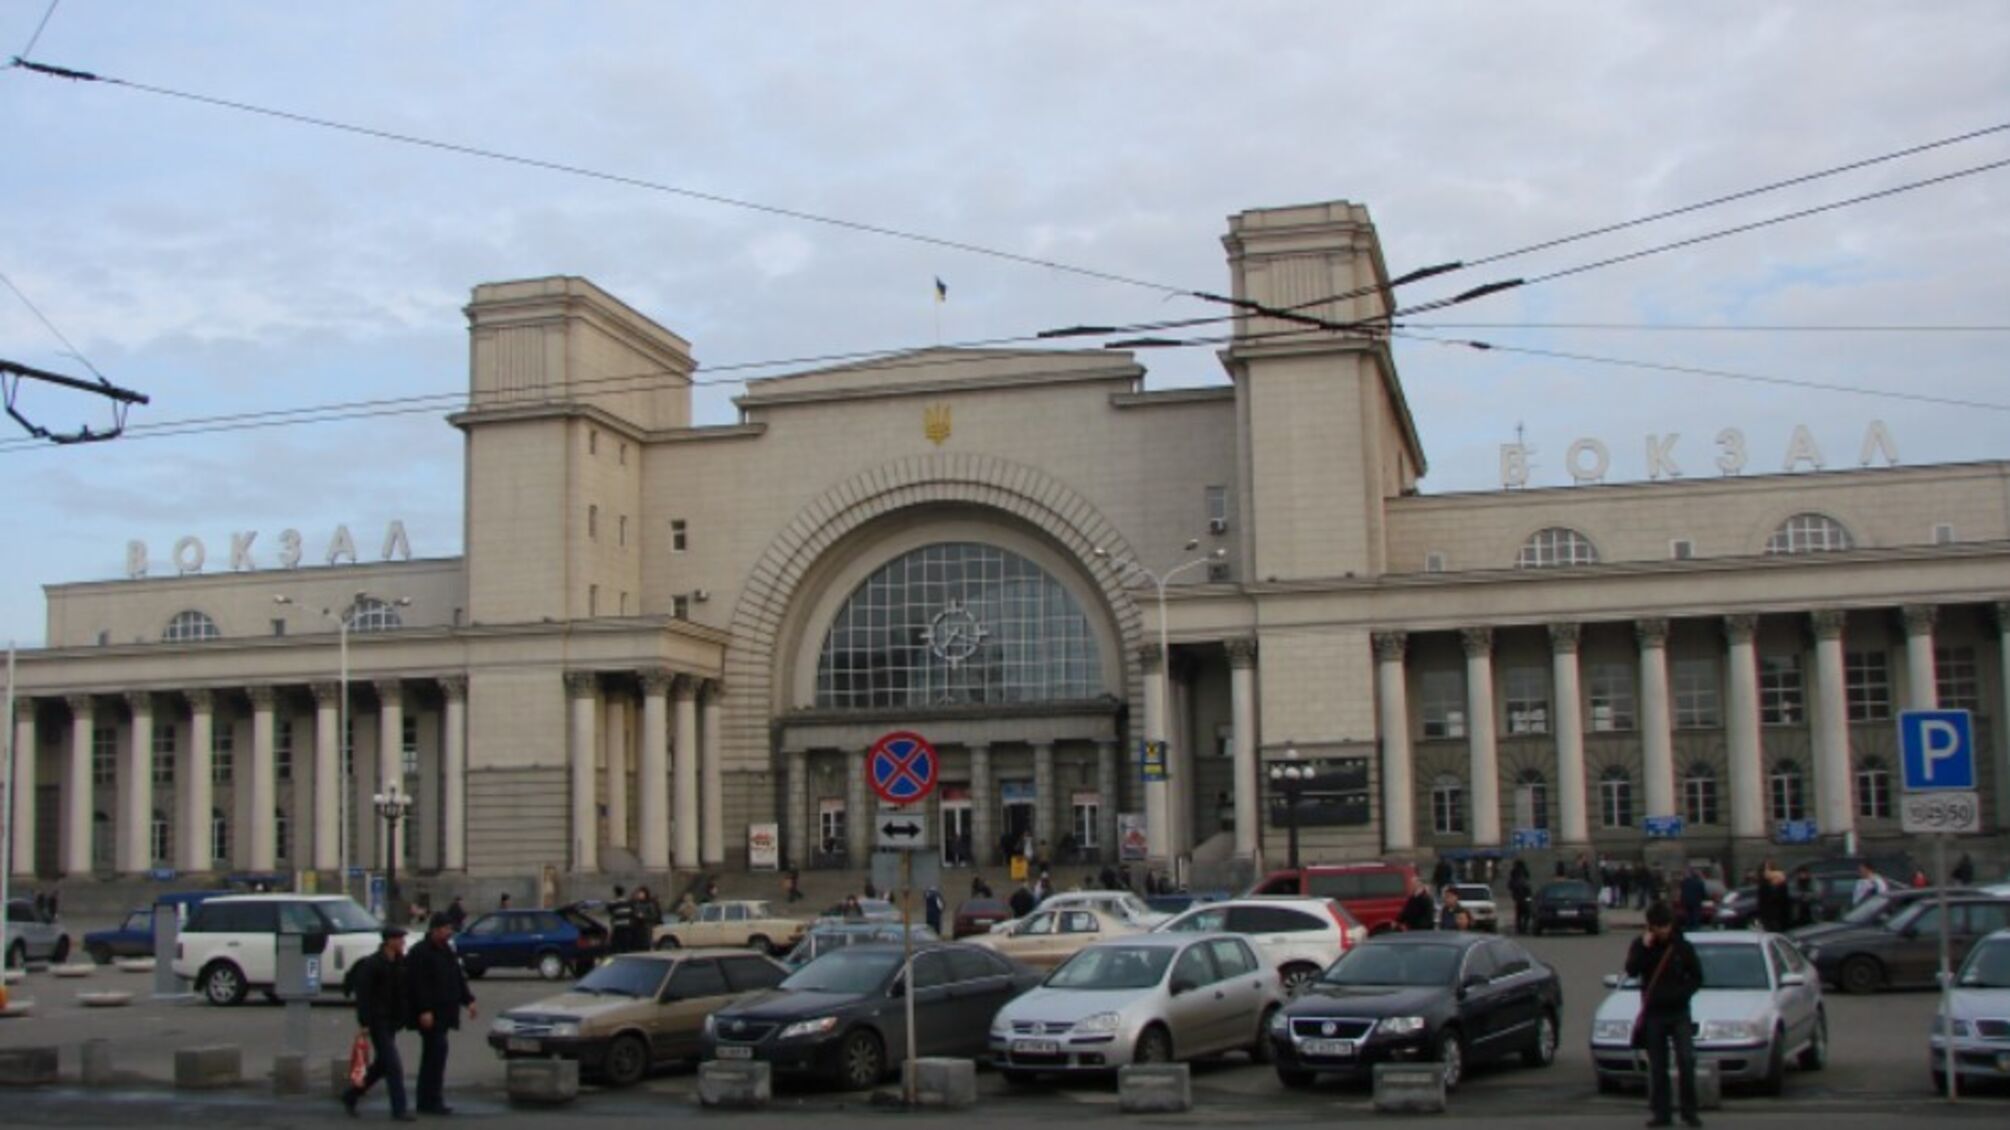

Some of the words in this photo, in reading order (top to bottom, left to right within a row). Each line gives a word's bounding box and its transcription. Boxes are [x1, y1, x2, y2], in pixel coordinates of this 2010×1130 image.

[1500, 419, 1899, 487] ВОКЗАЛ
[127, 520, 411, 576] ВОКЗАЛ
[1921, 720, 1959, 780] P
